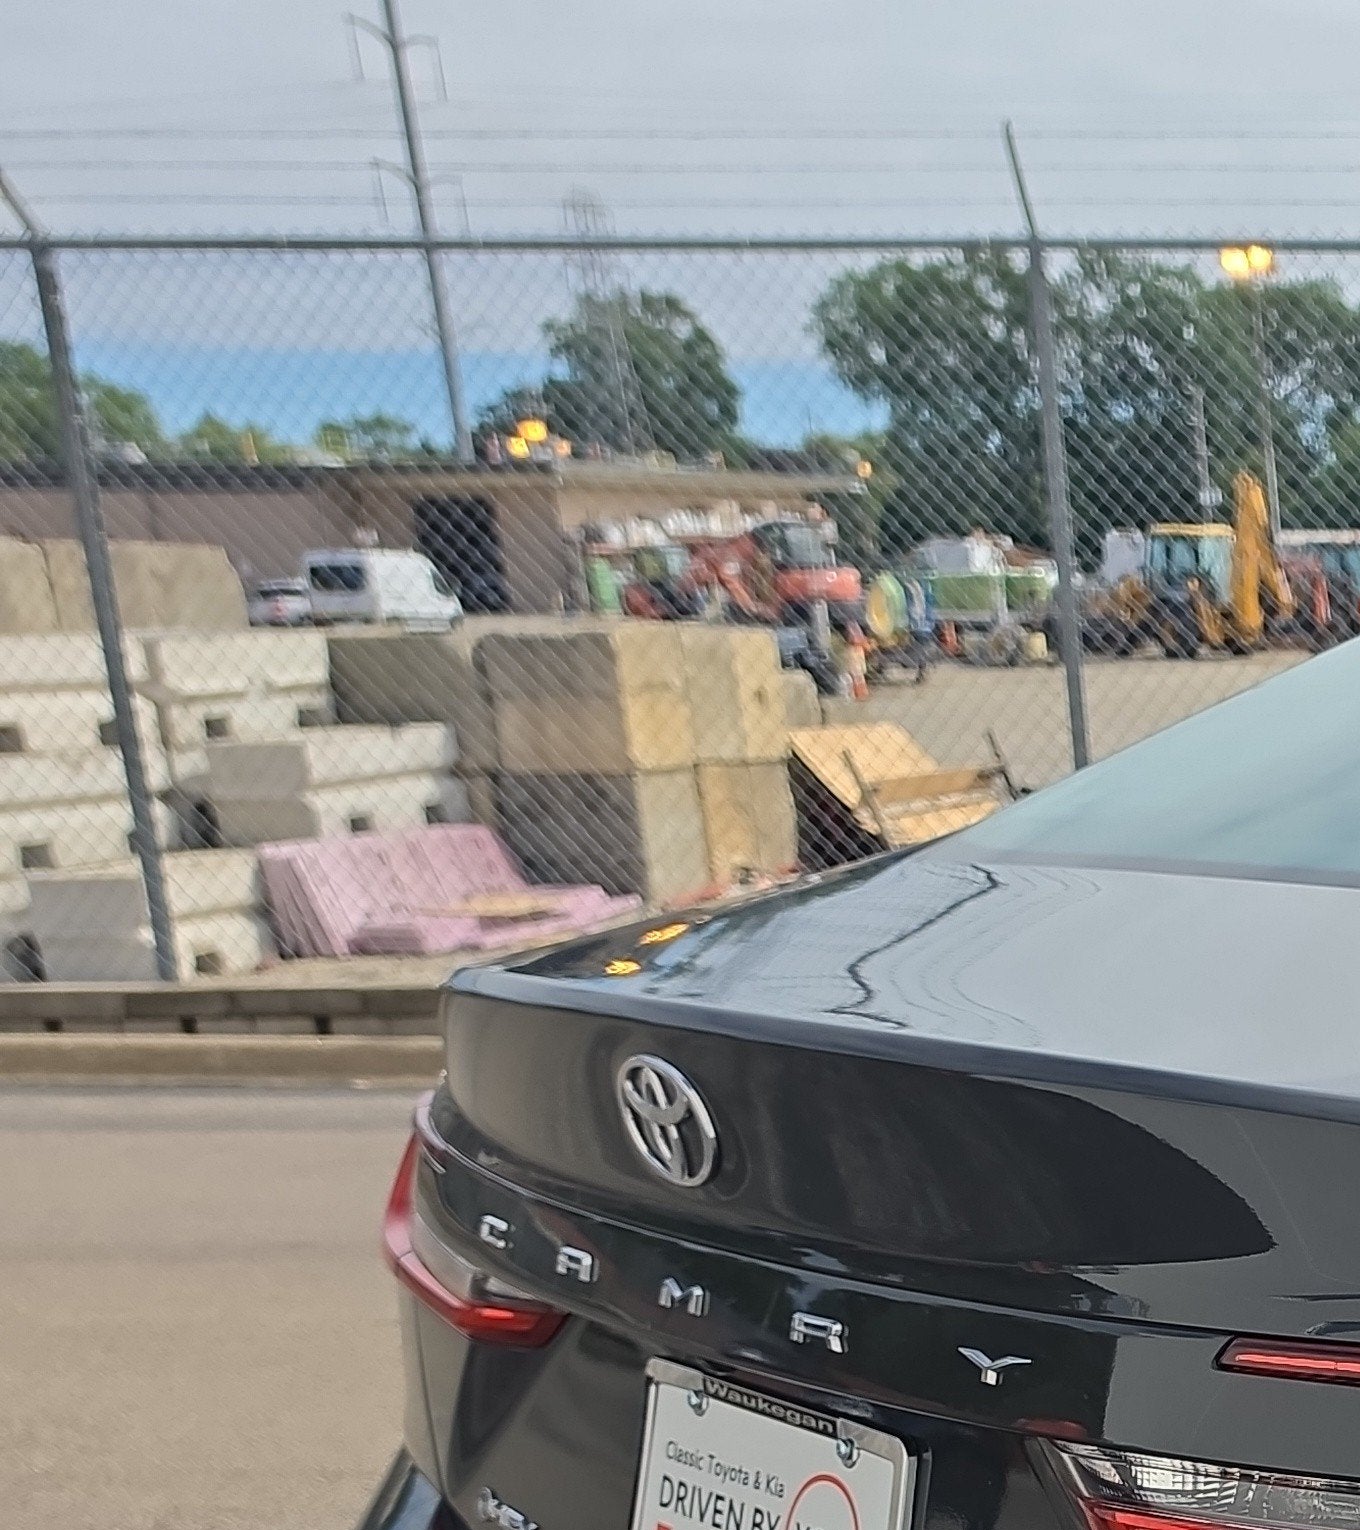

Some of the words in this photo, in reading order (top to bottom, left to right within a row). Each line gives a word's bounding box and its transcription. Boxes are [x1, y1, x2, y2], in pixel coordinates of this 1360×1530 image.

[478, 1213, 1032, 1388] CAMRY
[704, 1378, 833, 1433] Waukegan
[666, 1440, 704, 1471] Classic
[707, 1454, 749, 1486] Toyota
[752, 1472, 762, 1490] &
[765, 1477, 785, 1498] Kia
